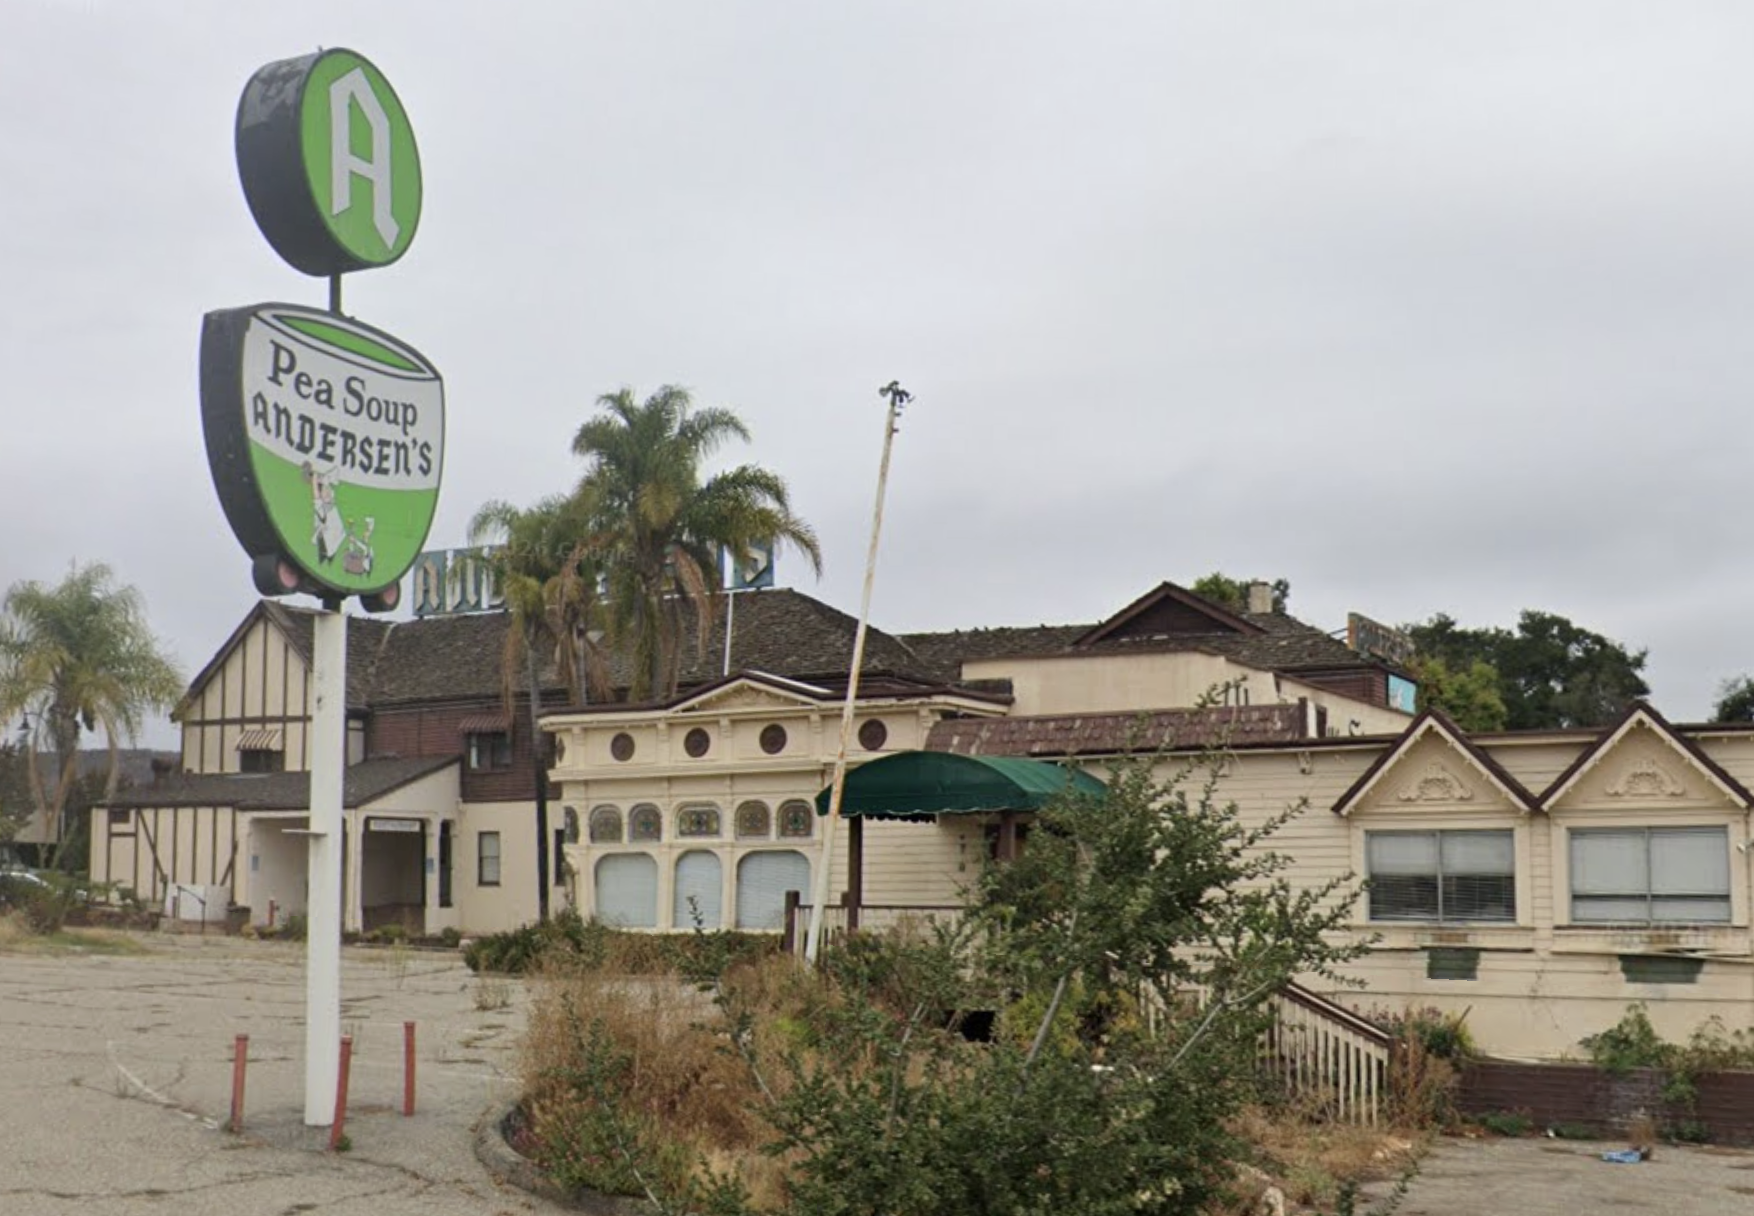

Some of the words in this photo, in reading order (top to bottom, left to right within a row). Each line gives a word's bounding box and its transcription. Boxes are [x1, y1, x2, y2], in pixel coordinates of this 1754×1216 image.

[329, 65, 400, 251] A
[252, 390, 433, 477] ANDERSEN'S
[267, 339, 335, 411] Pea
[343, 376, 418, 436] Soup
